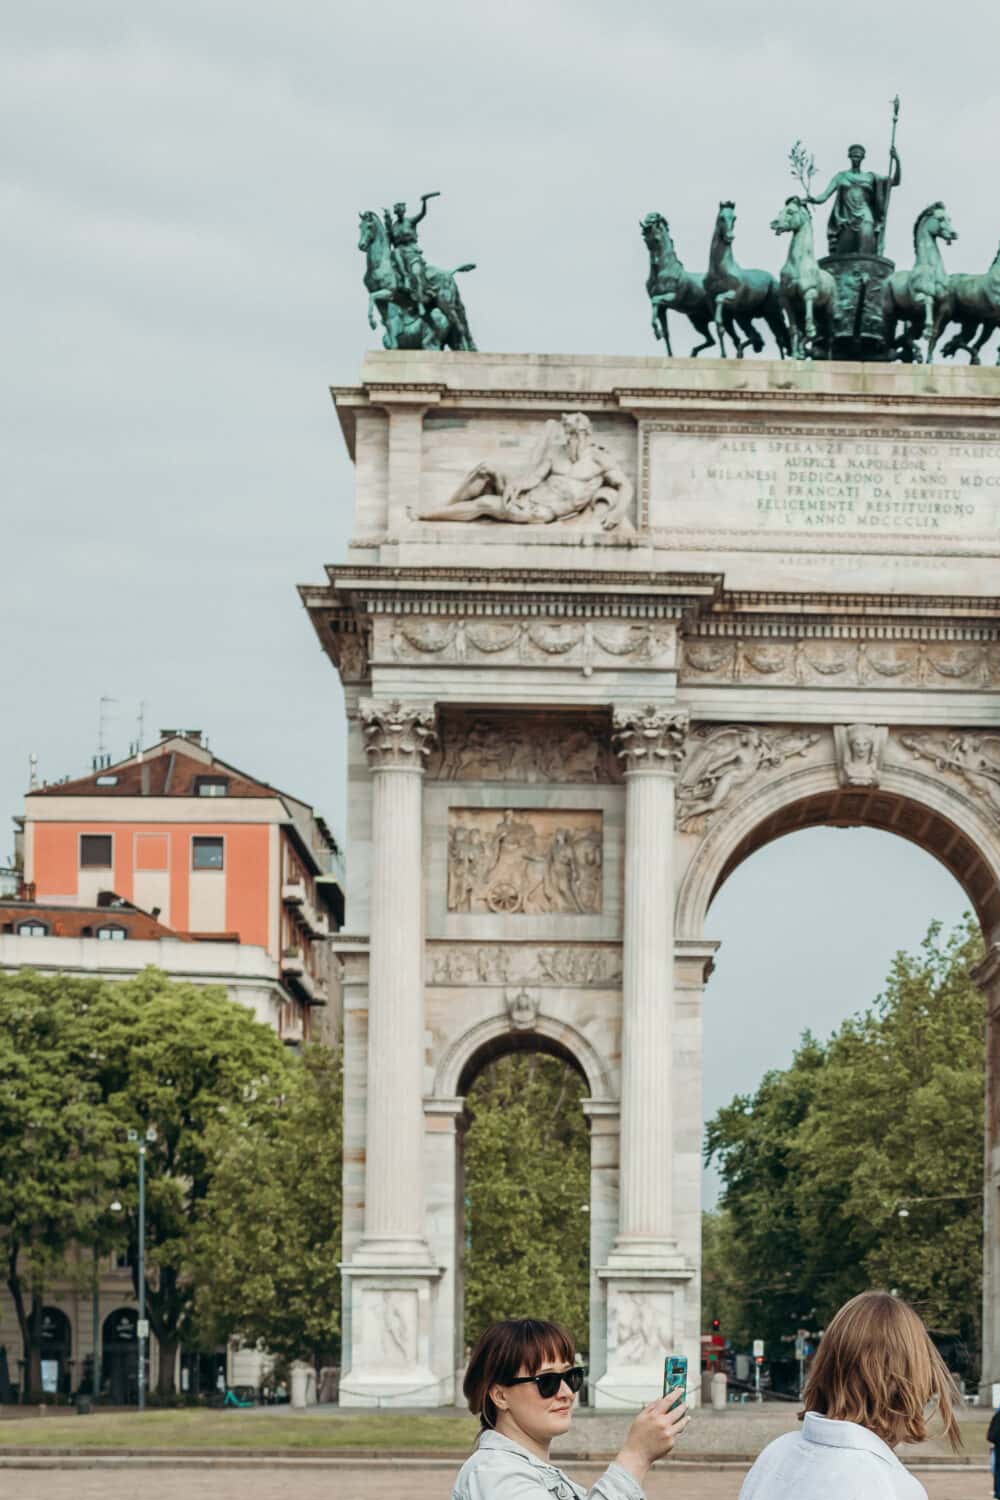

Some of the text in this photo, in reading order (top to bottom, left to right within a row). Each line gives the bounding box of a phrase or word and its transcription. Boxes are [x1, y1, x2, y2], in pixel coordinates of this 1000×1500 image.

[768, 443, 843, 455] SPERANZE
[891, 446, 938, 457] REGNO
[784, 457, 836, 469] AUSPICE
[847, 459, 926, 471] NAPOLEONE
[706, 469, 777, 482] MILANESI
[788, 471, 884, 484] DEDICARONO
[911, 474, 948, 486] ANNO
[787, 485, 860, 498] FRANCATI
[873, 488, 891, 499] DA
[756, 499, 975, 516] FELICEMENTE RESTITUIRONO
[804, 514, 846, 525] ANNO
